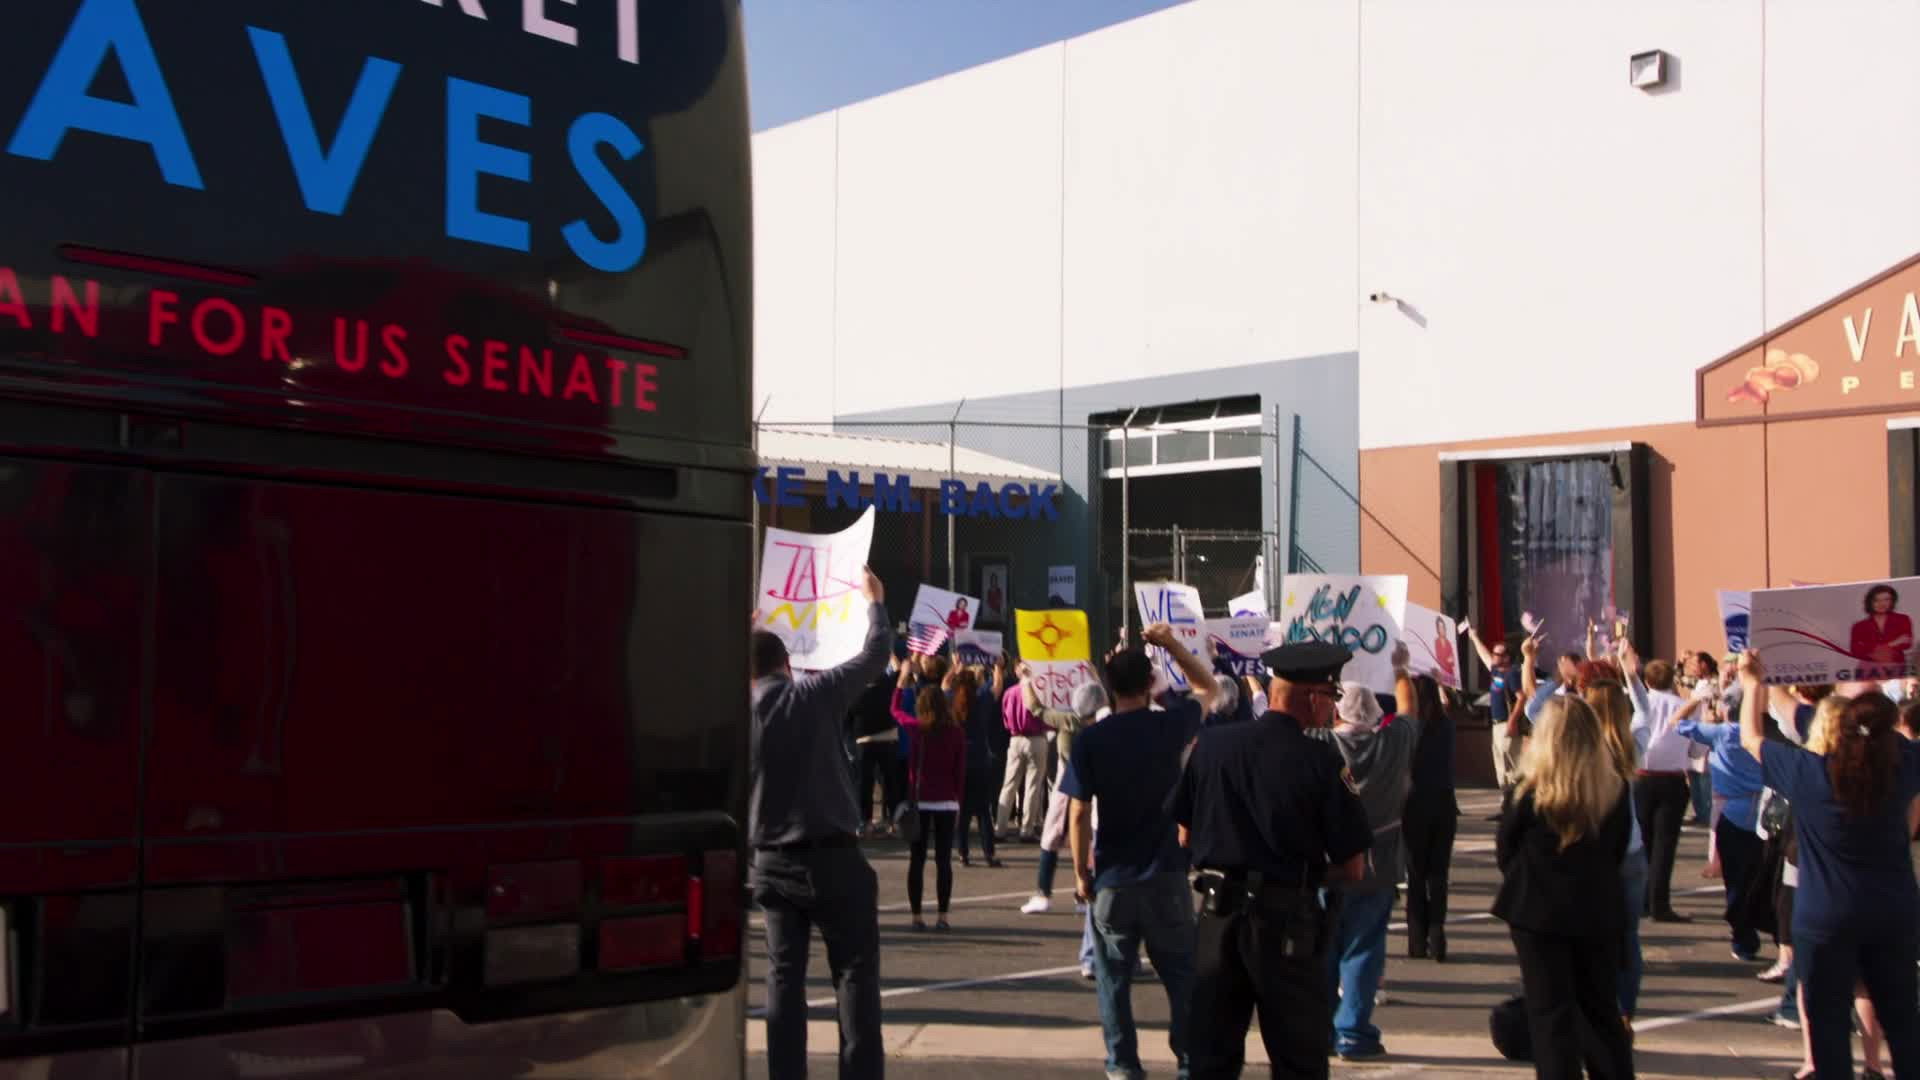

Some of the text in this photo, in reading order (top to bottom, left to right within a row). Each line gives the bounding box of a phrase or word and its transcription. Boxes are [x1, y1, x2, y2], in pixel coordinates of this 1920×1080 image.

[6, 0, 646, 272] AVES
[147, 290, 295, 363] FOR
[333, 316, 410, 379] US
[443, 333, 660, 412] SENATE
[939, 478, 1062, 522] BACK
[1140, 589, 1196, 624] WE
[1764, 673, 1828, 684] ARGARET
